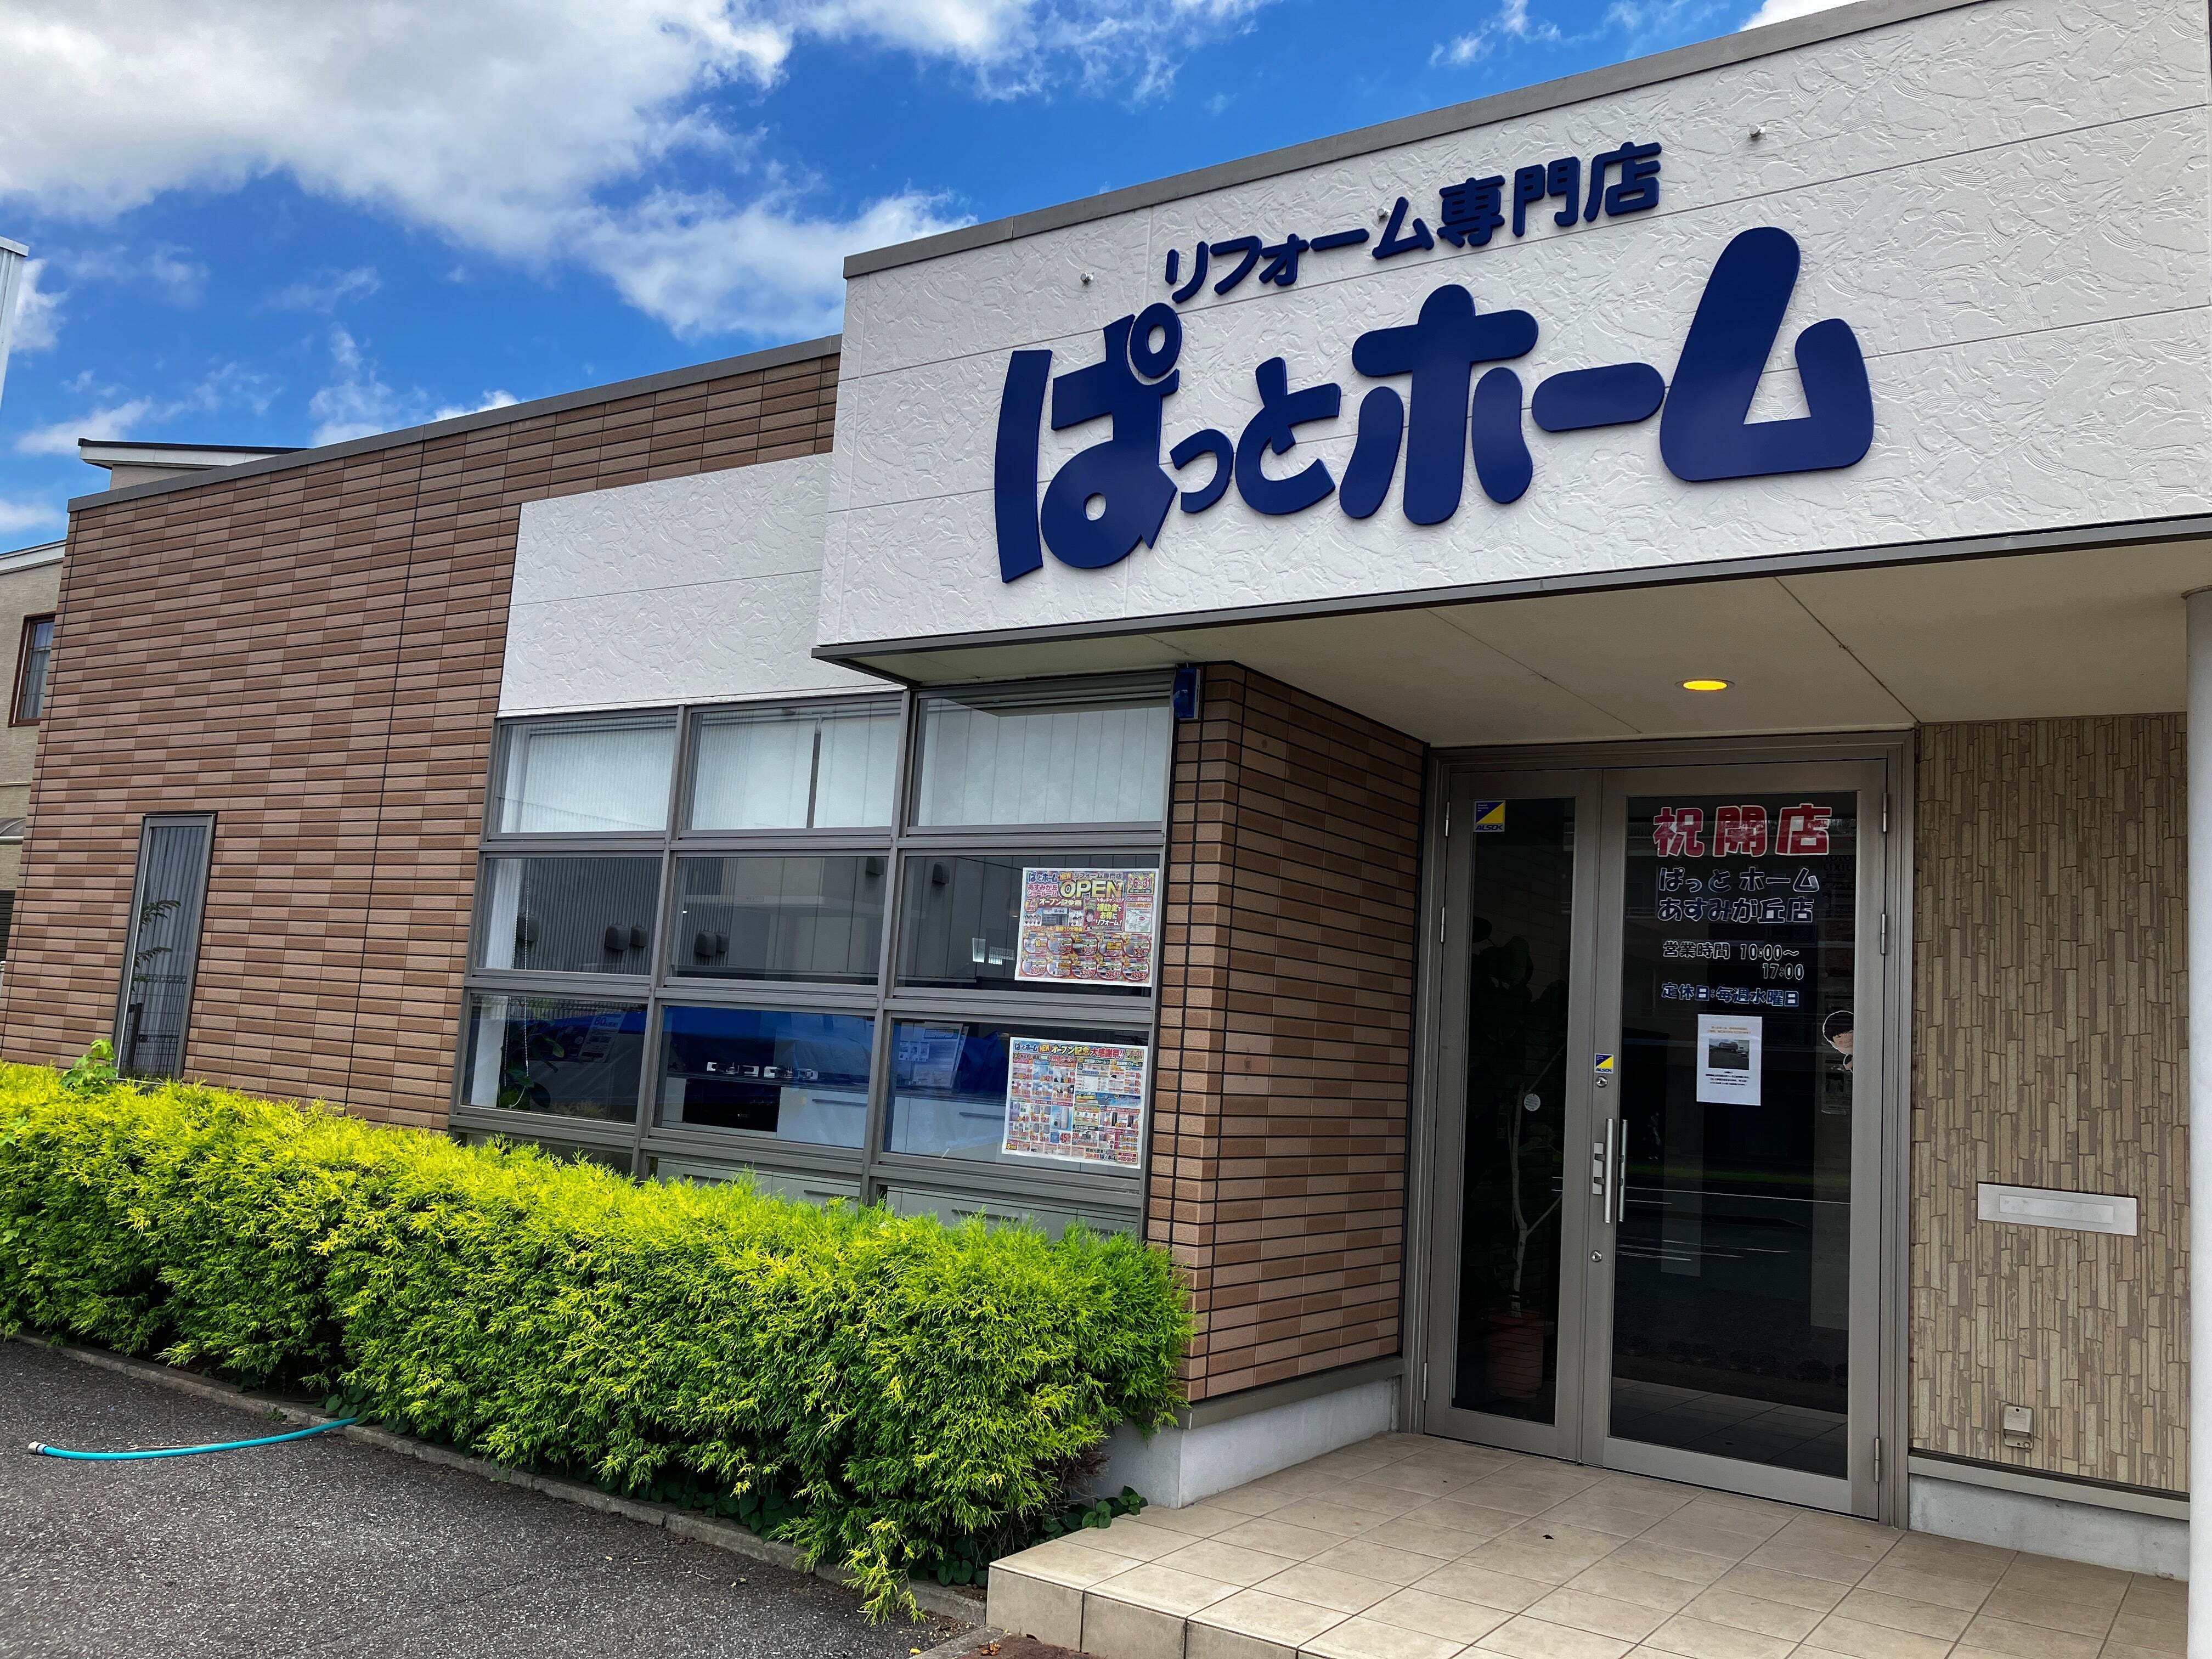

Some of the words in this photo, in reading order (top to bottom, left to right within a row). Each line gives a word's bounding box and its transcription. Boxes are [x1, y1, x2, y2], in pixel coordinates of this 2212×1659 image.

[1165, 142, 1662, 303] リフォーム専門店
[994, 226, 1875, 583] ぱっとホーム
[1059, 879, 1124, 899] OPEN
[1657, 896, 1814, 923] あすみが丘店
[1662, 940, 1731, 960] 営業時間
[1762, 963, 1804, 980] 17:00
